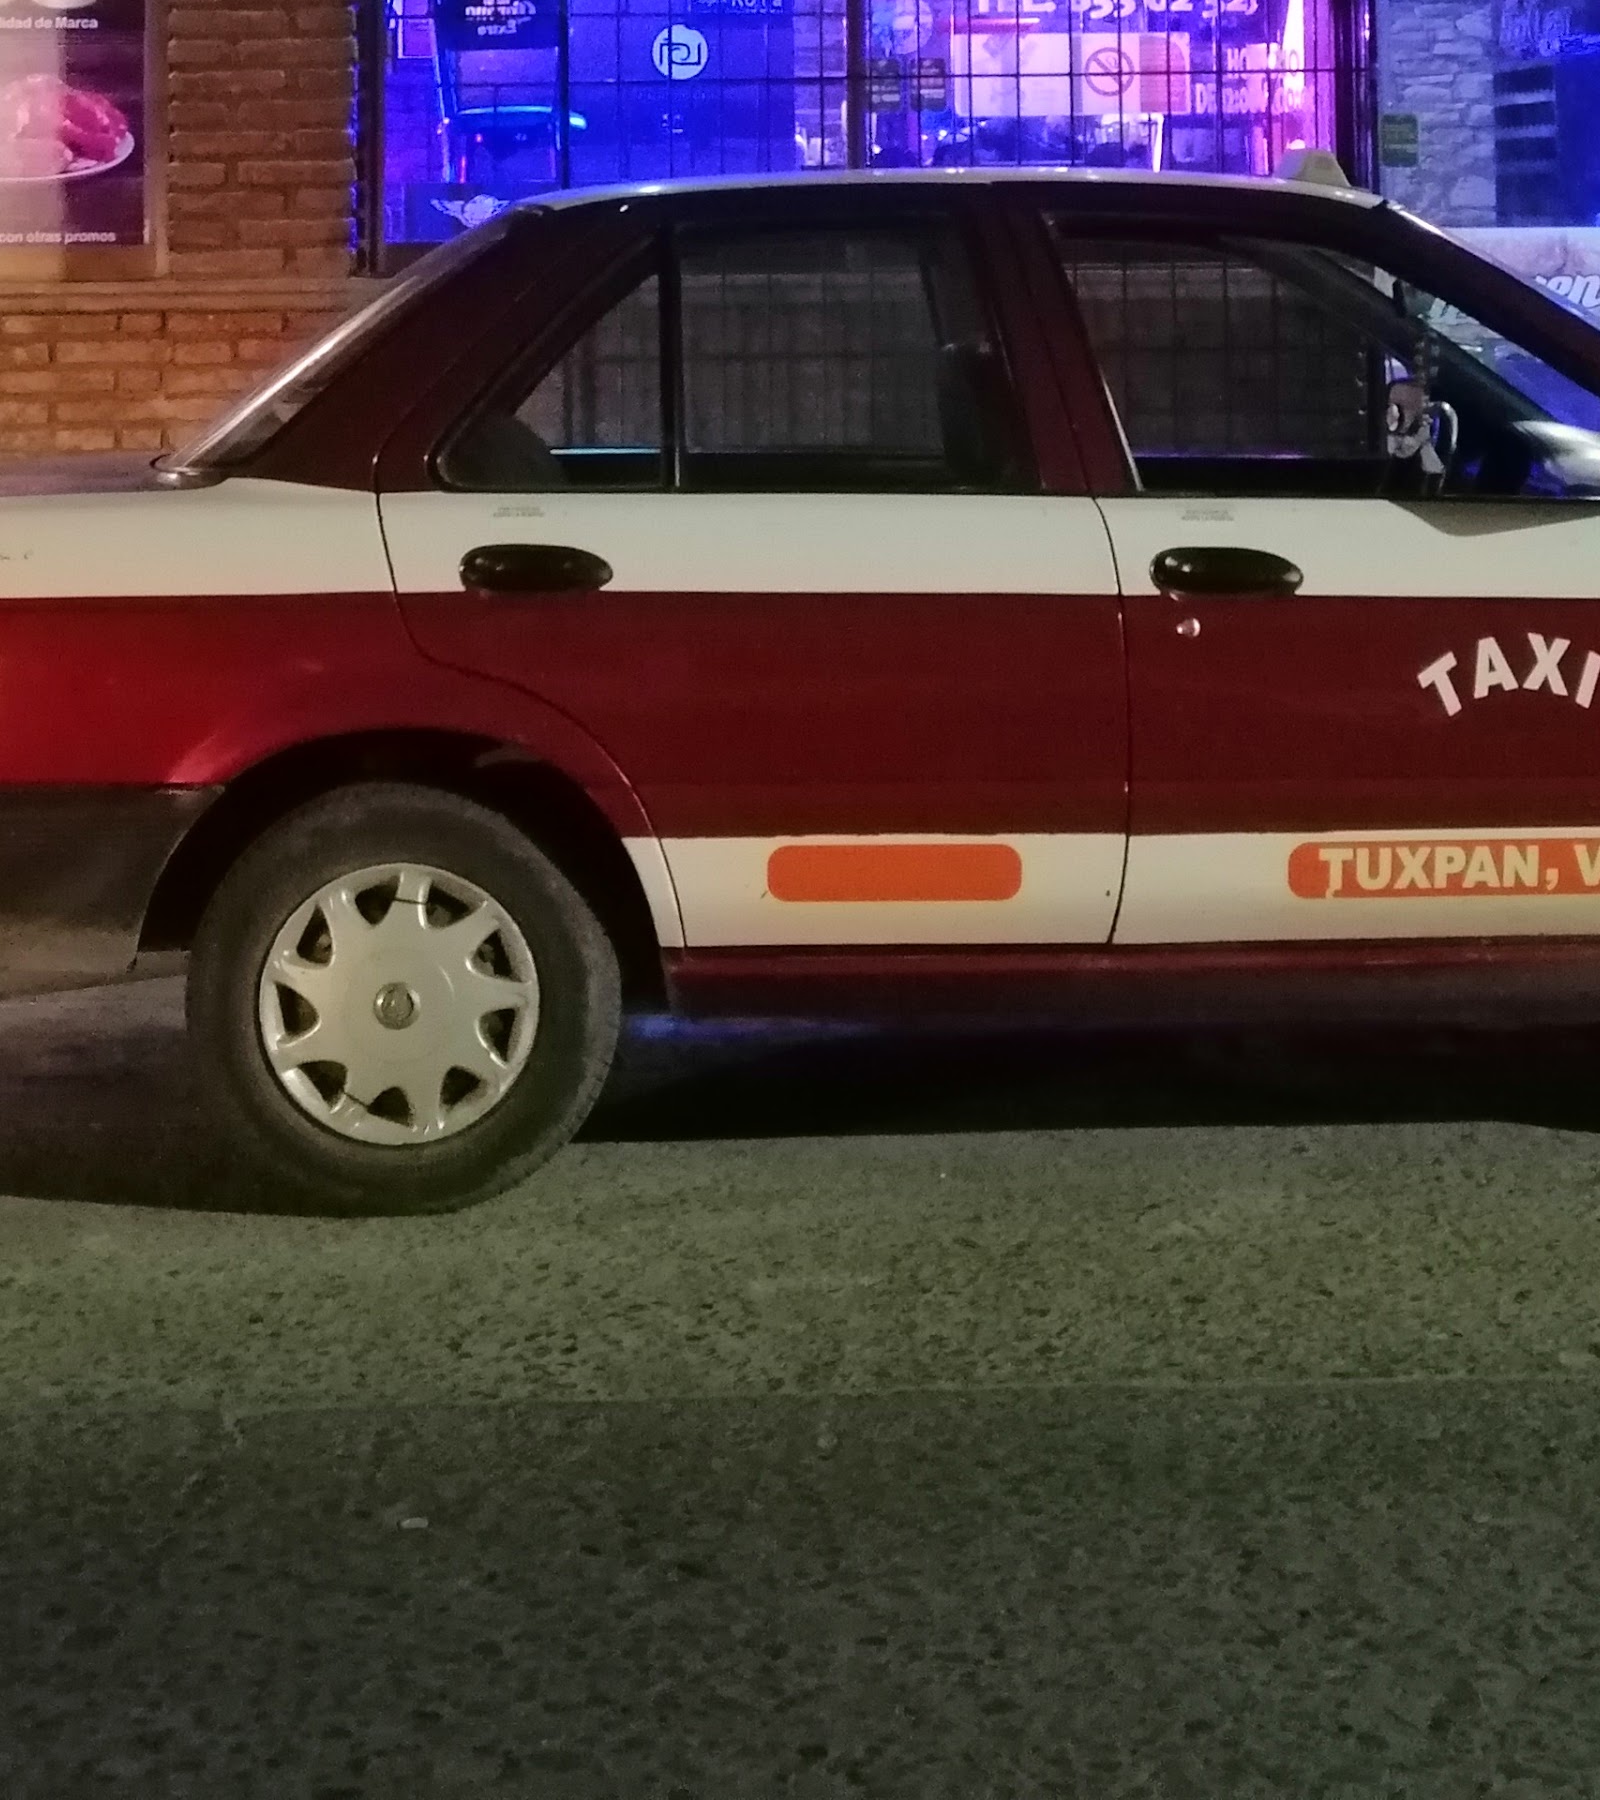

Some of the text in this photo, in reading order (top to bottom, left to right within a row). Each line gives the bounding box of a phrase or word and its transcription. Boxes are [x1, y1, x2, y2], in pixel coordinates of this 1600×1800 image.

[34, 16, 52, 30] de
[55, 16, 99, 30] Marca
[26, 231, 62, 243] otras
[64, 231, 117, 245] promos
[1318, 842, 1560, 897] TUXPAN,
